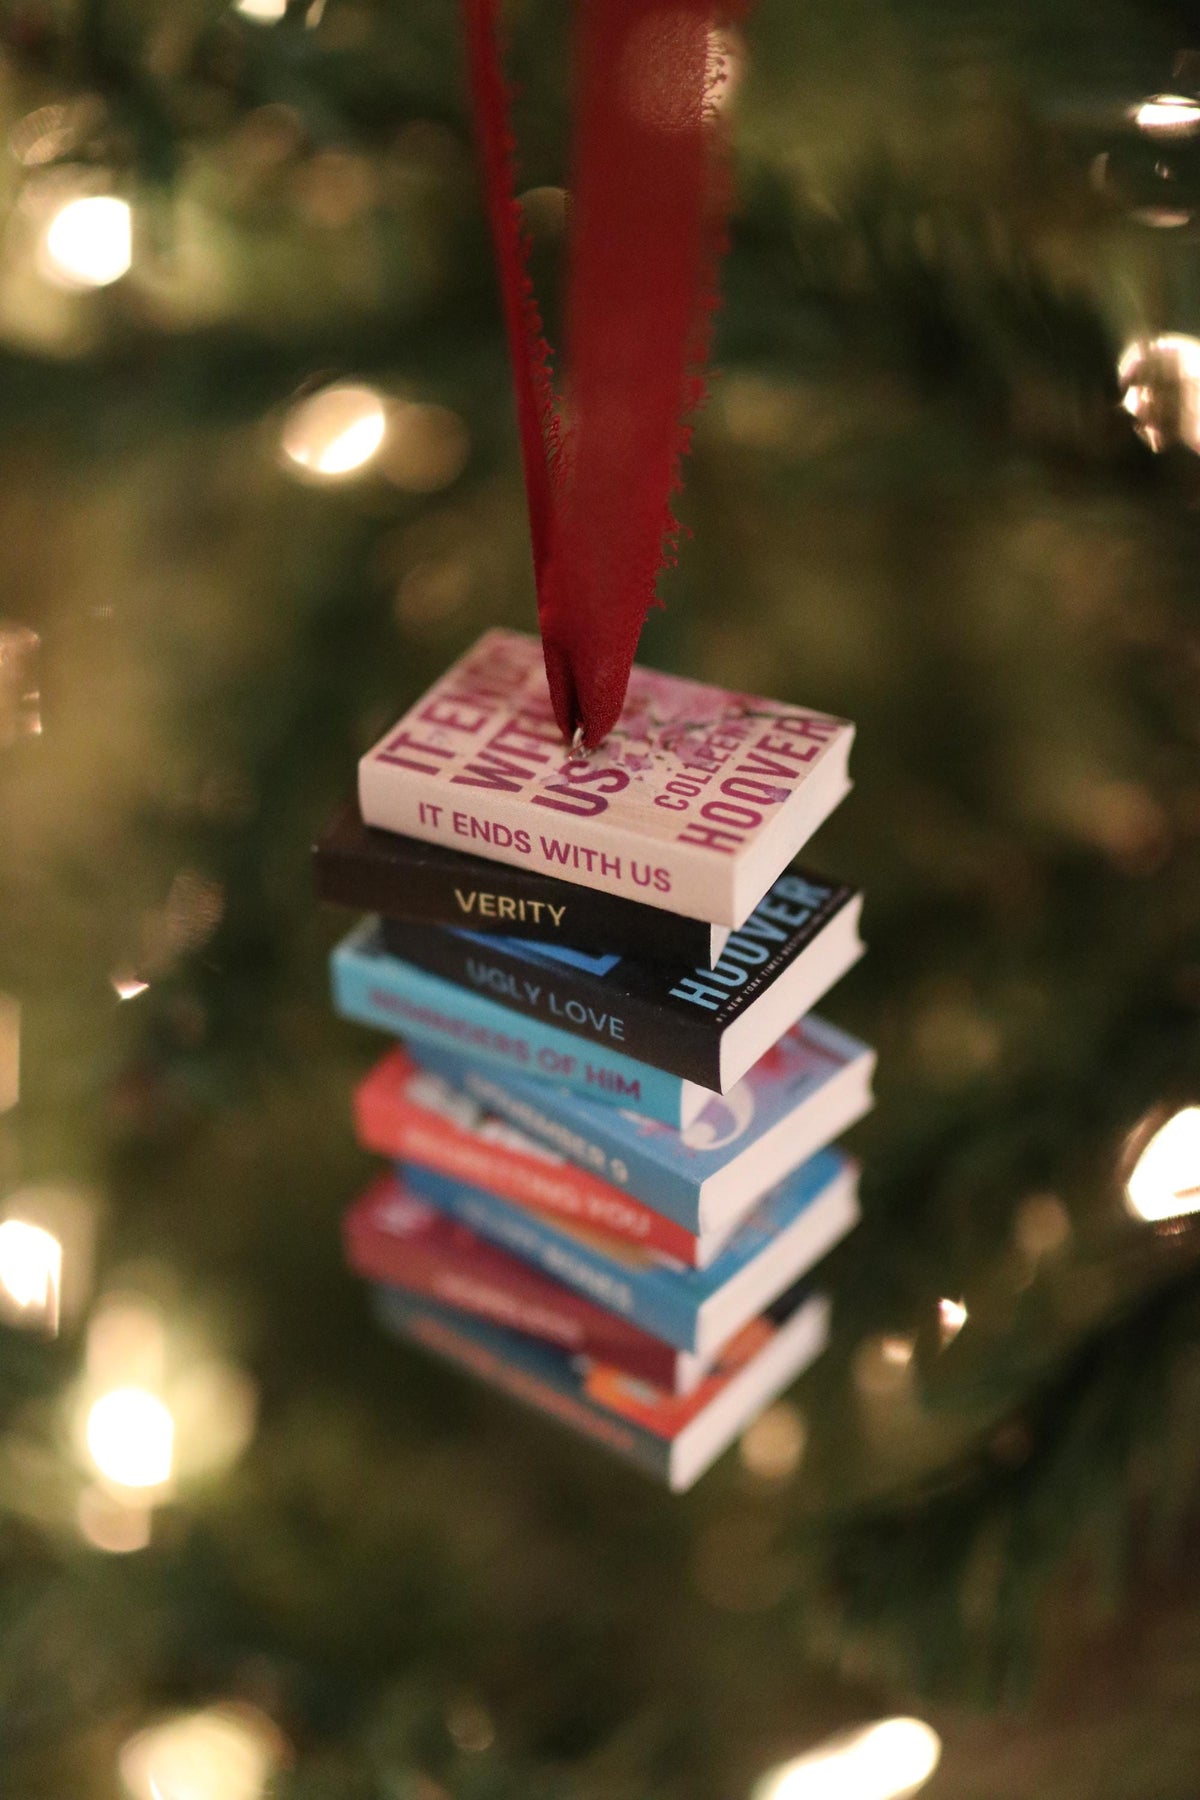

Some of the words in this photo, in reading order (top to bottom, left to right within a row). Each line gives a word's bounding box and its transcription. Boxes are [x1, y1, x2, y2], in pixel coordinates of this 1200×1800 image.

[375, 732, 456, 776] IT
[530, 760, 631, 817] US
[676, 716, 840, 855] HOOVER
[418, 803, 443, 828] IT
[452, 811, 532, 854] ENDS
[539, 836, 621, 879] WITH
[630, 861, 672, 893] US
[454, 888, 567, 927] VERITY
[669, 875, 832, 1011] HOOVER
[464, 957, 542, 1006] UGLY
[550, 992, 626, 1042] LOVE
[726, 996, 744, 1012] NEW
[743, 977, 763, 996] YORK
[761, 955, 784, 978] TIMES
[537, 1046, 578, 1077] OF
[584, 1063, 642, 1101] HIM
